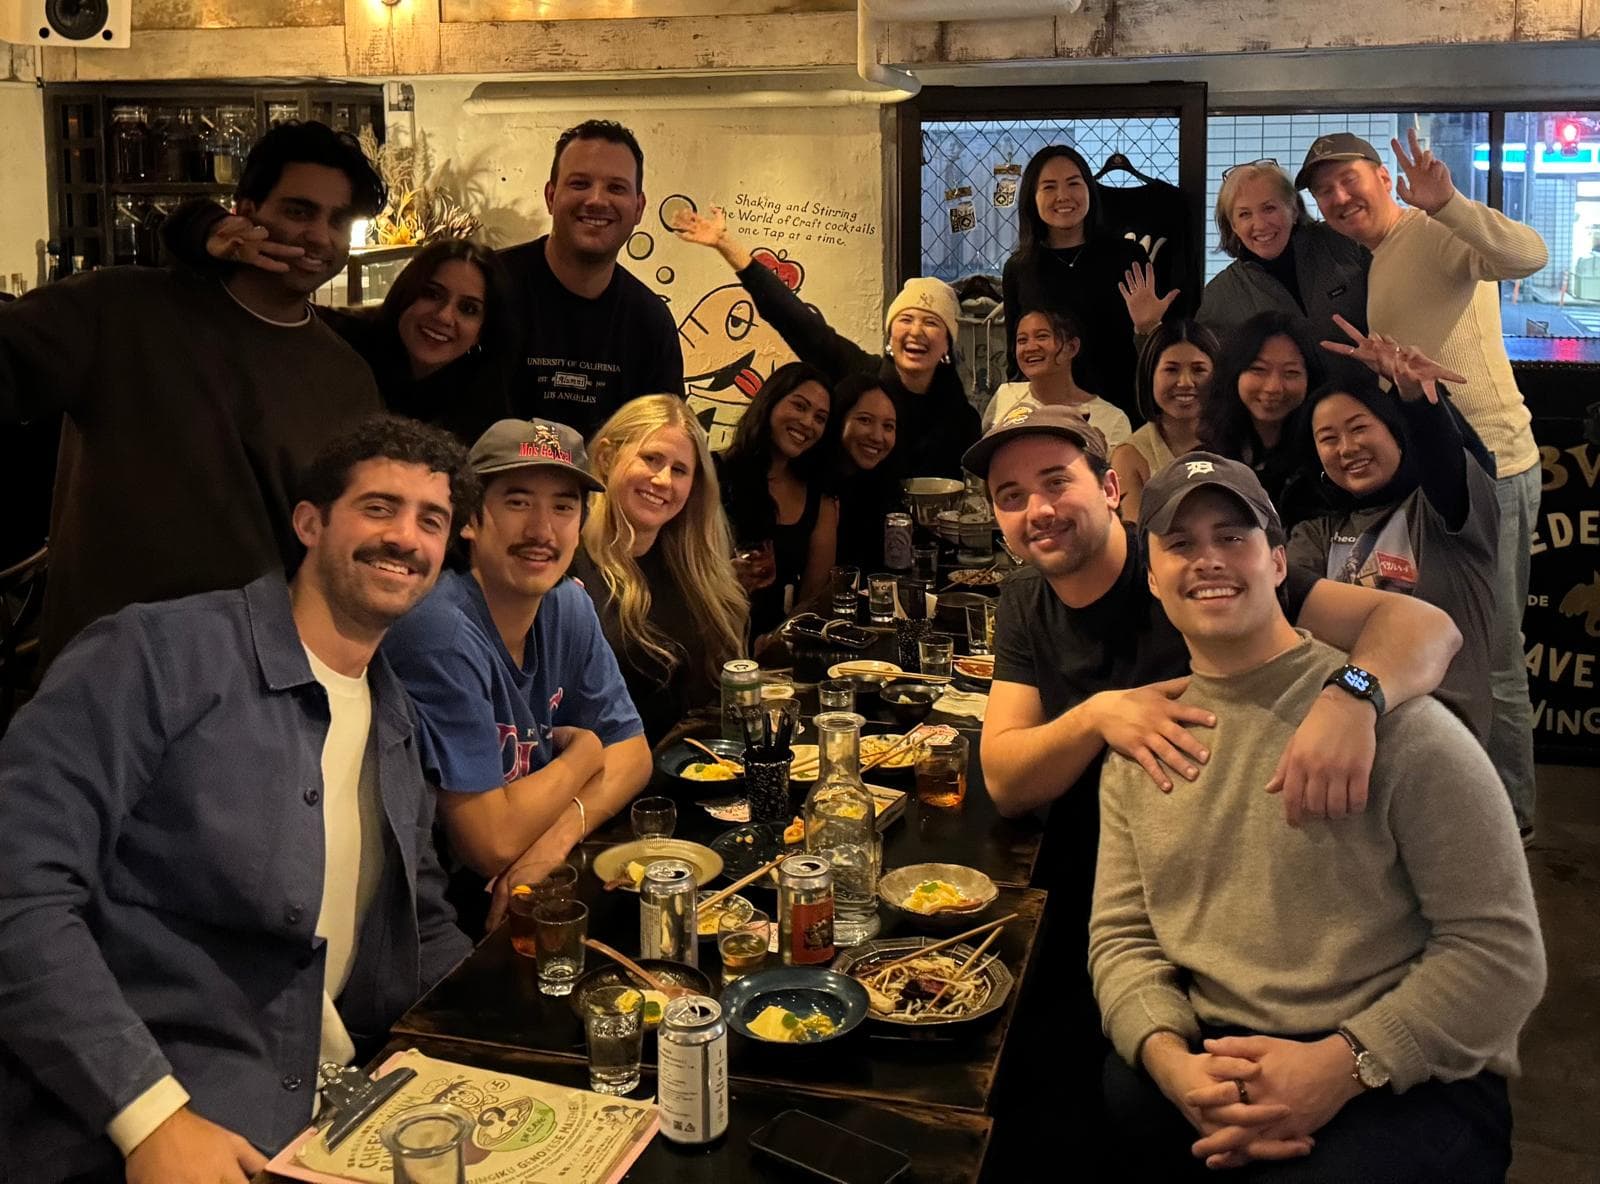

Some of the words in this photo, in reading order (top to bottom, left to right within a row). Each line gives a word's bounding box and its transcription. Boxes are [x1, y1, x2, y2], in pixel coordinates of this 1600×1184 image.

[735, 193, 782, 214] Shaking
[786, 201, 810, 213] and
[812, 202, 858, 222] Stirring
[738, 209, 774, 222] World
[777, 215, 792, 225] of
[792, 216, 822, 229] Craft
[738, 226, 760, 236] one
[763, 227, 785, 241] Tap
[788, 232, 800, 240] at
[817, 233, 847, 247] time.
[527, 357, 565, 367] UNIVERSITY
[579, 361, 621, 372] CALIFORNIA
[518, 442, 539, 457] Mo's
